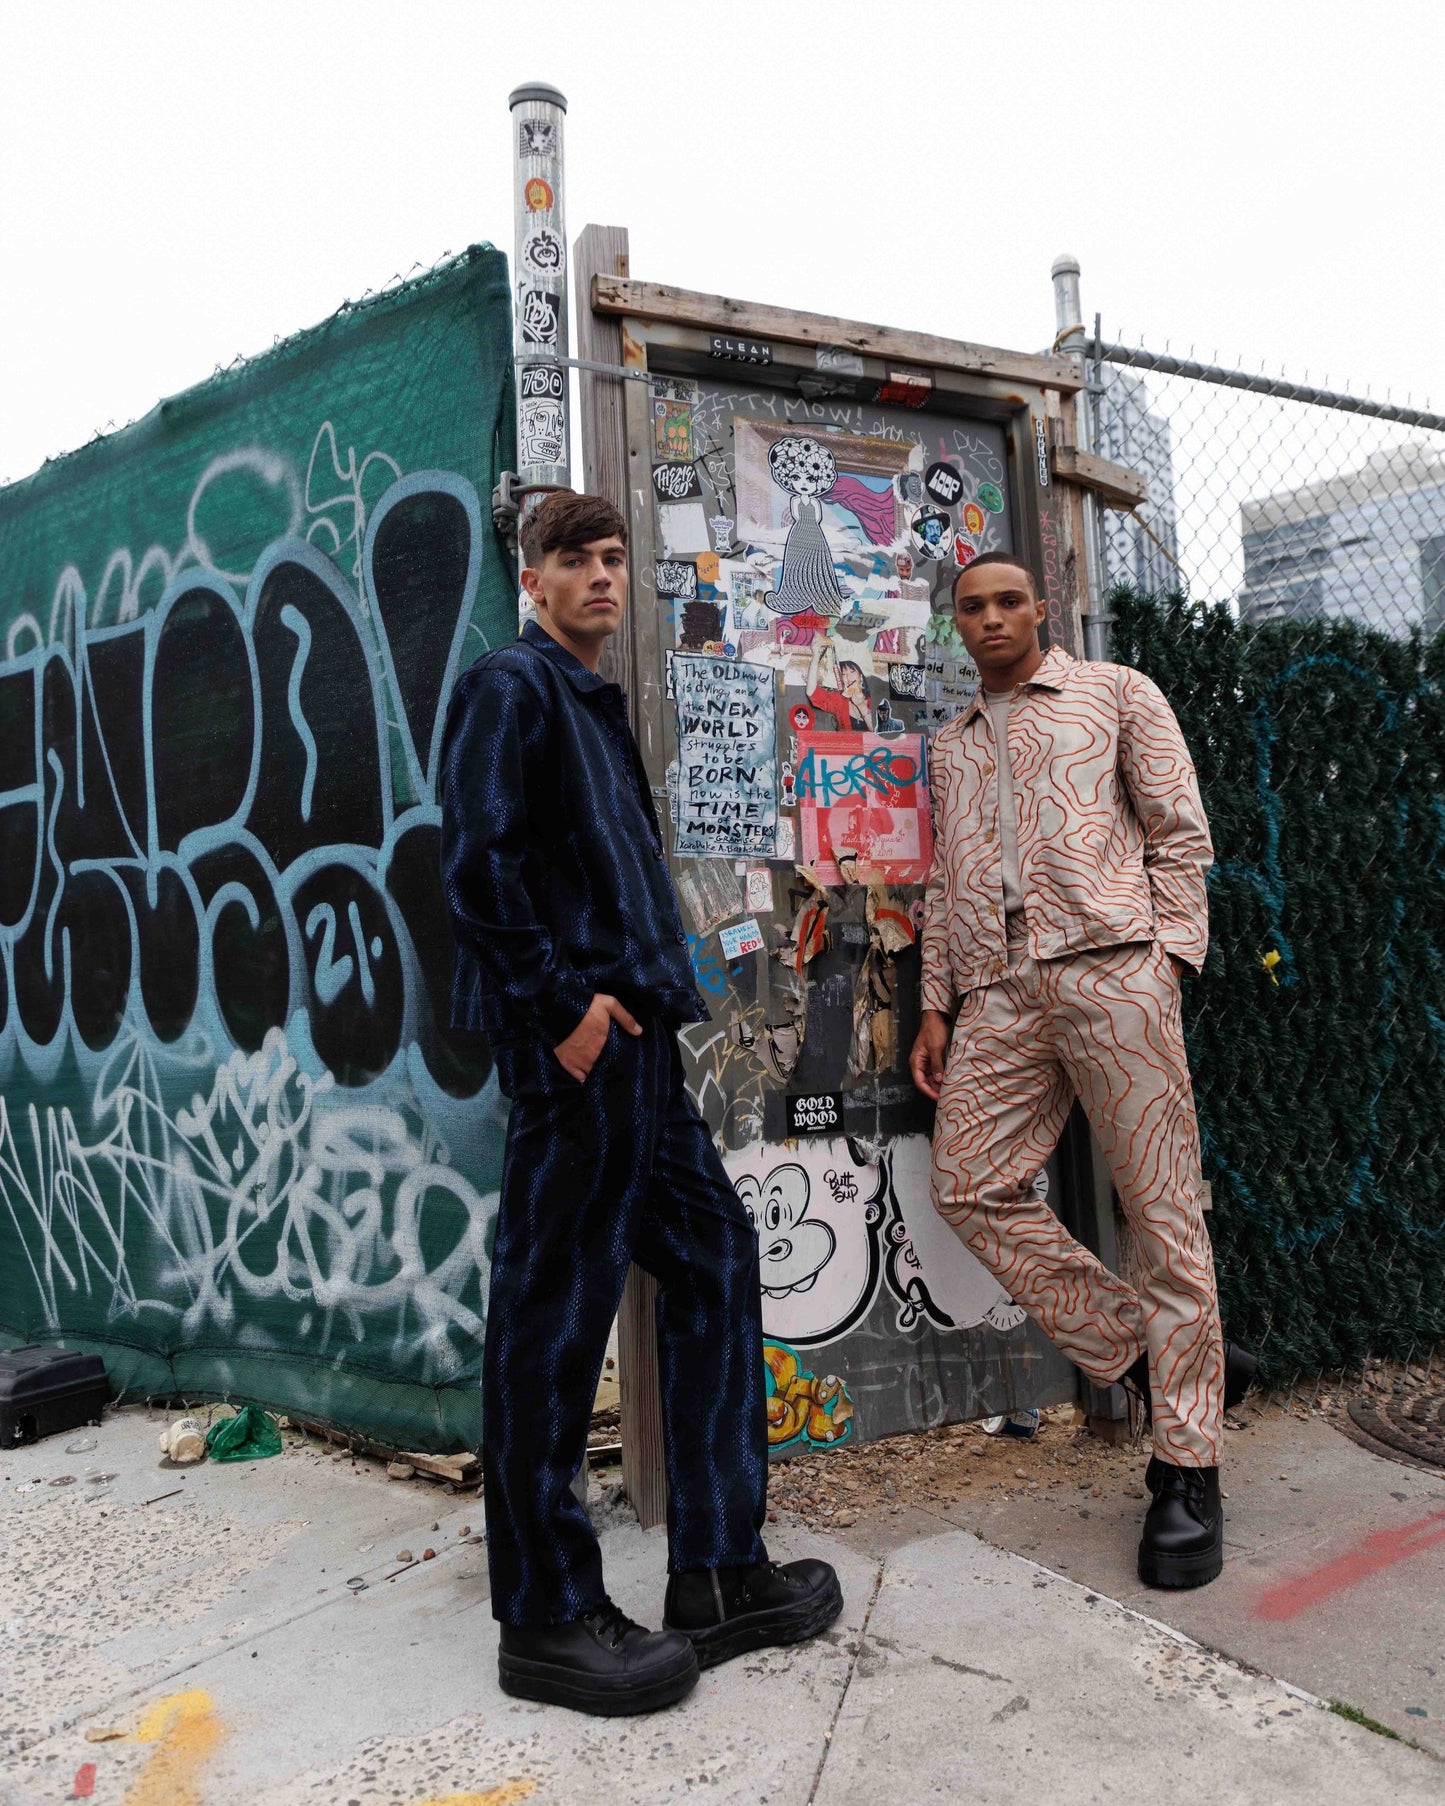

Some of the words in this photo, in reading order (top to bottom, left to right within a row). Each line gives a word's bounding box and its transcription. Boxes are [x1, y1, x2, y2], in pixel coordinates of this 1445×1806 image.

[714, 339, 770, 356] CLEAN
[681, 663, 708, 680] The
[712, 665, 740, 681] OLD
[742, 671, 770, 685] world
[926, 661, 945, 674] old
[958, 664, 980, 681] day
[682, 680, 692, 693] is
[735, 687, 758, 697] and
[942, 684, 955, 695] the
[956, 688, 976, 698] whol
[685, 701, 705, 712] the
[707, 699, 760, 719] NEW
[683, 716, 760, 738] WORLD
[702, 752, 718, 764] to
[723, 754, 744, 766] be
[690, 789, 722, 801] now
[729, 788, 741, 799] is
[746, 787, 773, 800] the
[688, 801, 760, 819] TIME
[717, 815, 731, 824] of
[740, 940, 758, 954] RED
[796, 1095, 835, 1112] GOLD
[793, 1110, 838, 1128] WOOD
